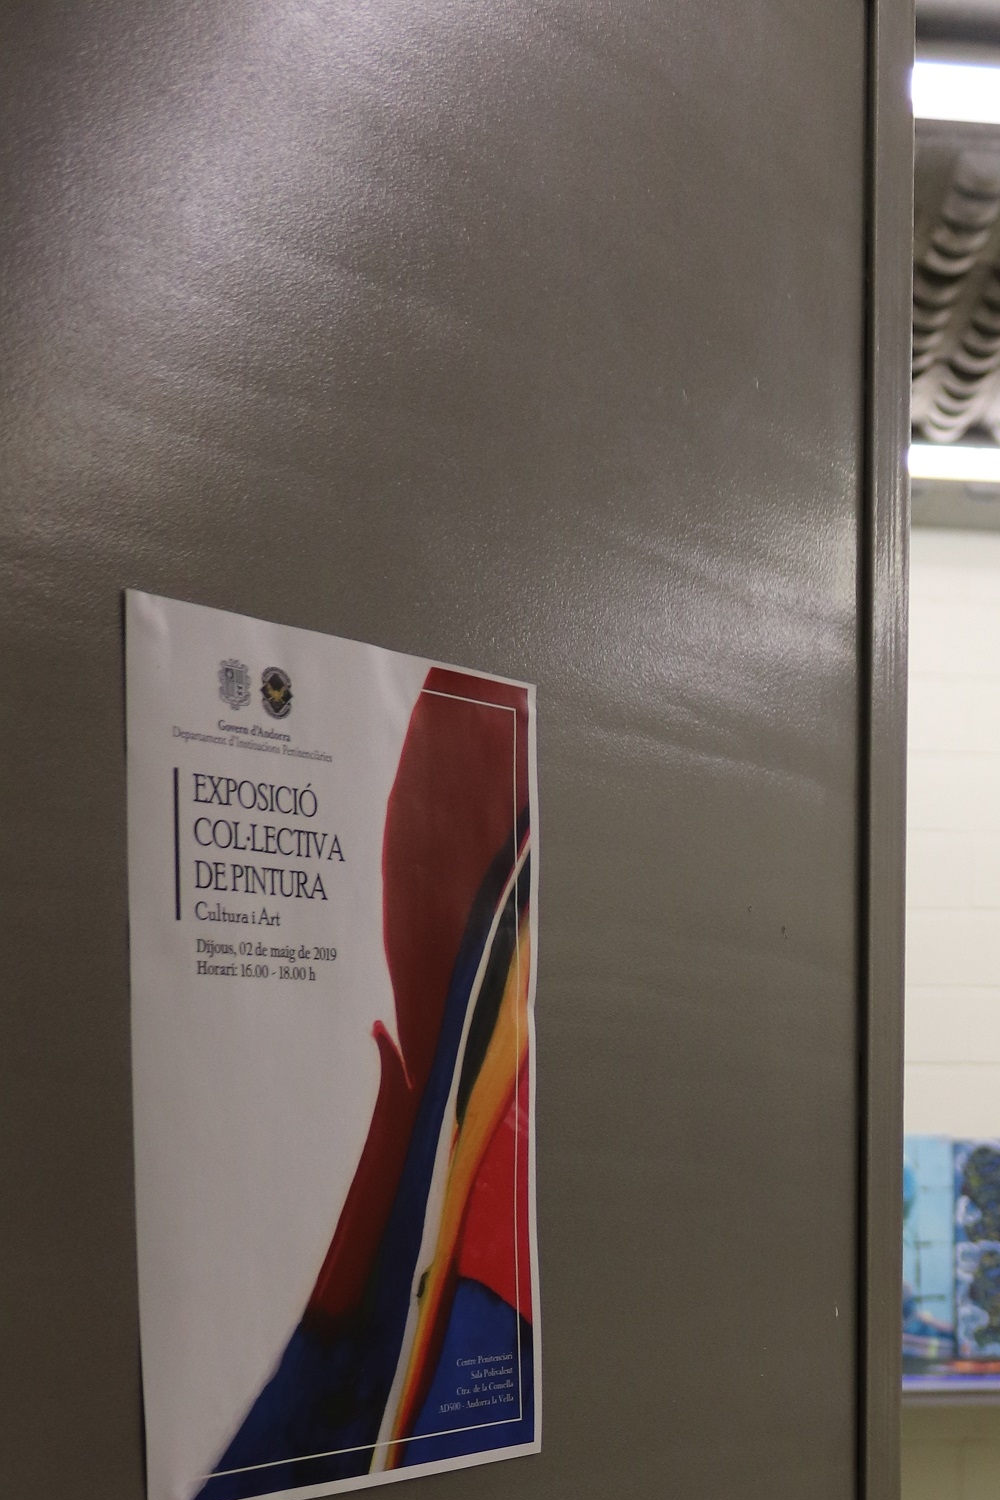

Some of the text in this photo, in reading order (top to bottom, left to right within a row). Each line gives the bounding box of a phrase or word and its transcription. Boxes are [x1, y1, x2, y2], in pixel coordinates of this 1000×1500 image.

[172, 725, 227, 745] Departament
[218, 720, 291, 742] Govern d'Andorra
[193, 773, 318, 818] EXPOSICIÓ
[194, 817, 346, 862] COL·LECTIVA
[194, 860, 328, 900] DE PINTURA
[195, 901, 281, 926] Cultura i Art
[196, 938, 337, 963] Dijous, 02 de maig de 2019
[196, 960, 238, 976] Horari:
[240, 963, 269, 978] 16.00
[279, 965, 306, 980] 18.00
[308, 967, 316, 981] h
[456, 1352, 513, 1367] Centre Penitenciari
[471, 1366, 513, 1379] Sala Polivalent
[473, 1384, 480, 1393] de
[482, 1383, 487, 1391] la
[488, 1379, 514, 1390] Comella
[466, 1399, 490, 1408] Andorra
[491, 1396, 497, 1404] la
[498, 1393, 514, 1402] Vella
